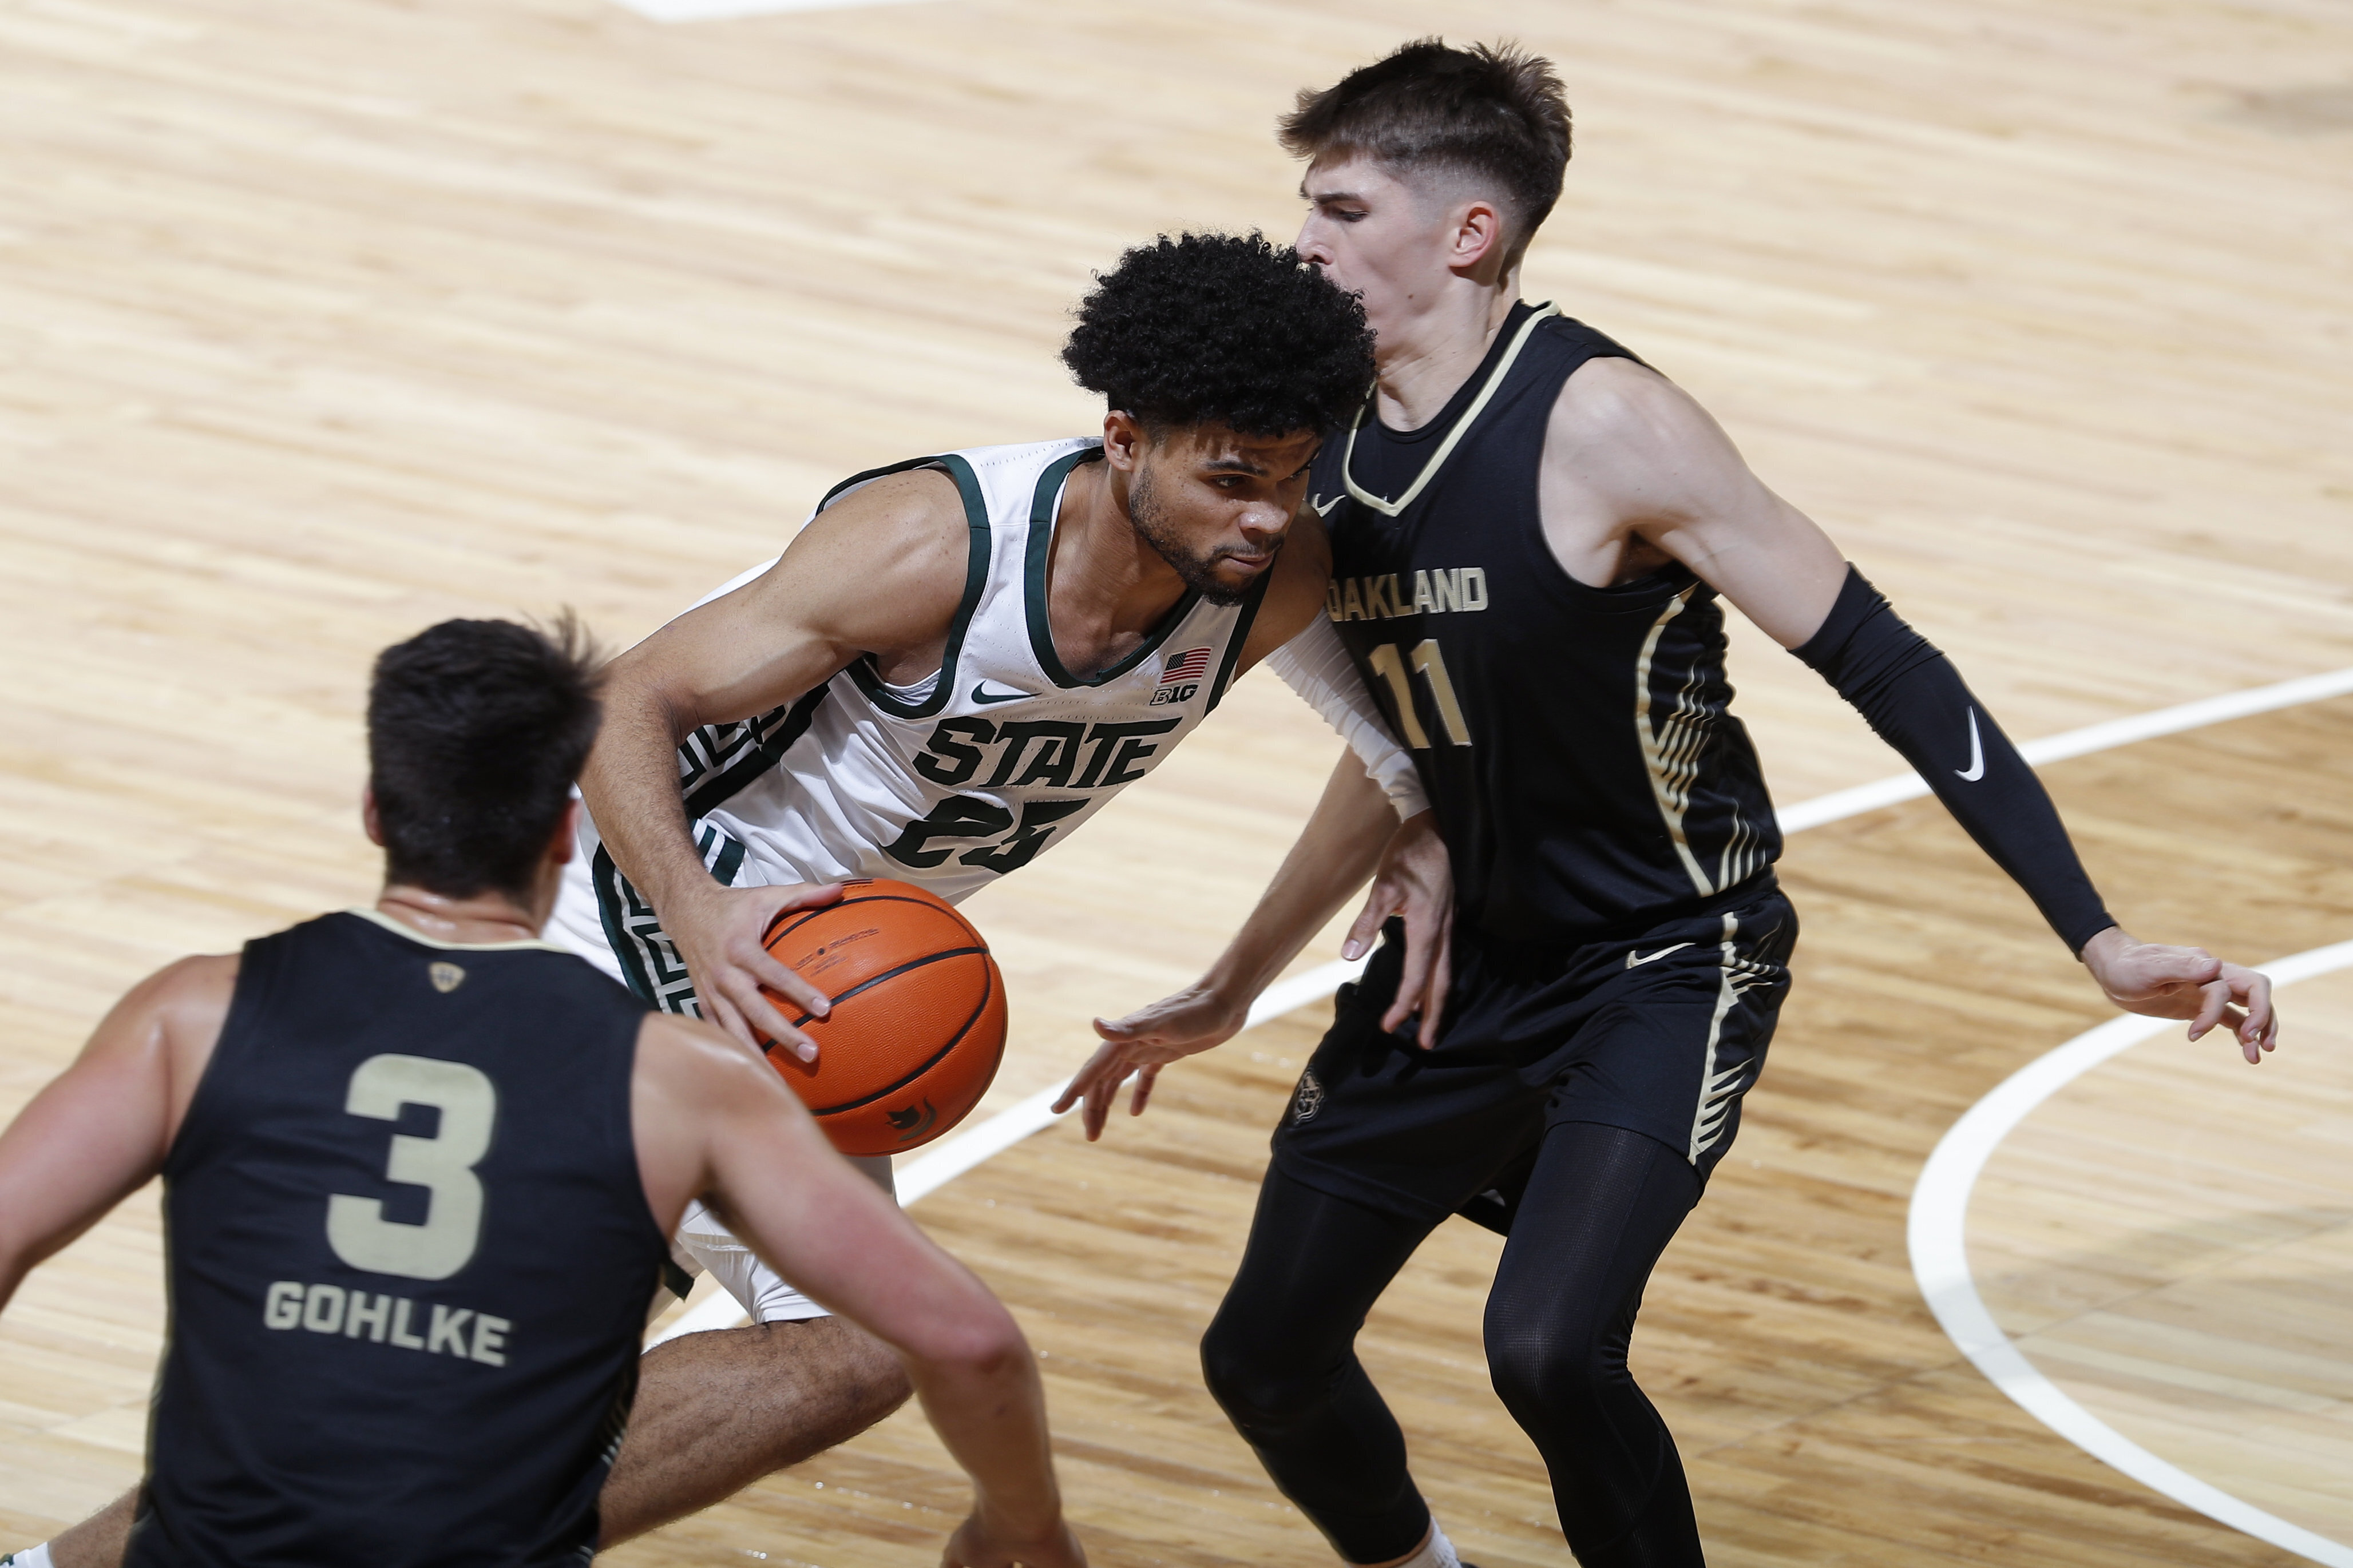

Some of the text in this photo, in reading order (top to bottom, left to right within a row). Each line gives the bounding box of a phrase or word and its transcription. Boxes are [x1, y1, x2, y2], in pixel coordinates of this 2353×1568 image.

[1326, 566, 1489, 622] OAKLAND
[1368, 638, 1472, 749] 11
[912, 716, 1183, 788] STATE
[326, 1053, 497, 1281] 3
[264, 1281, 512, 1367] GOHLKE
